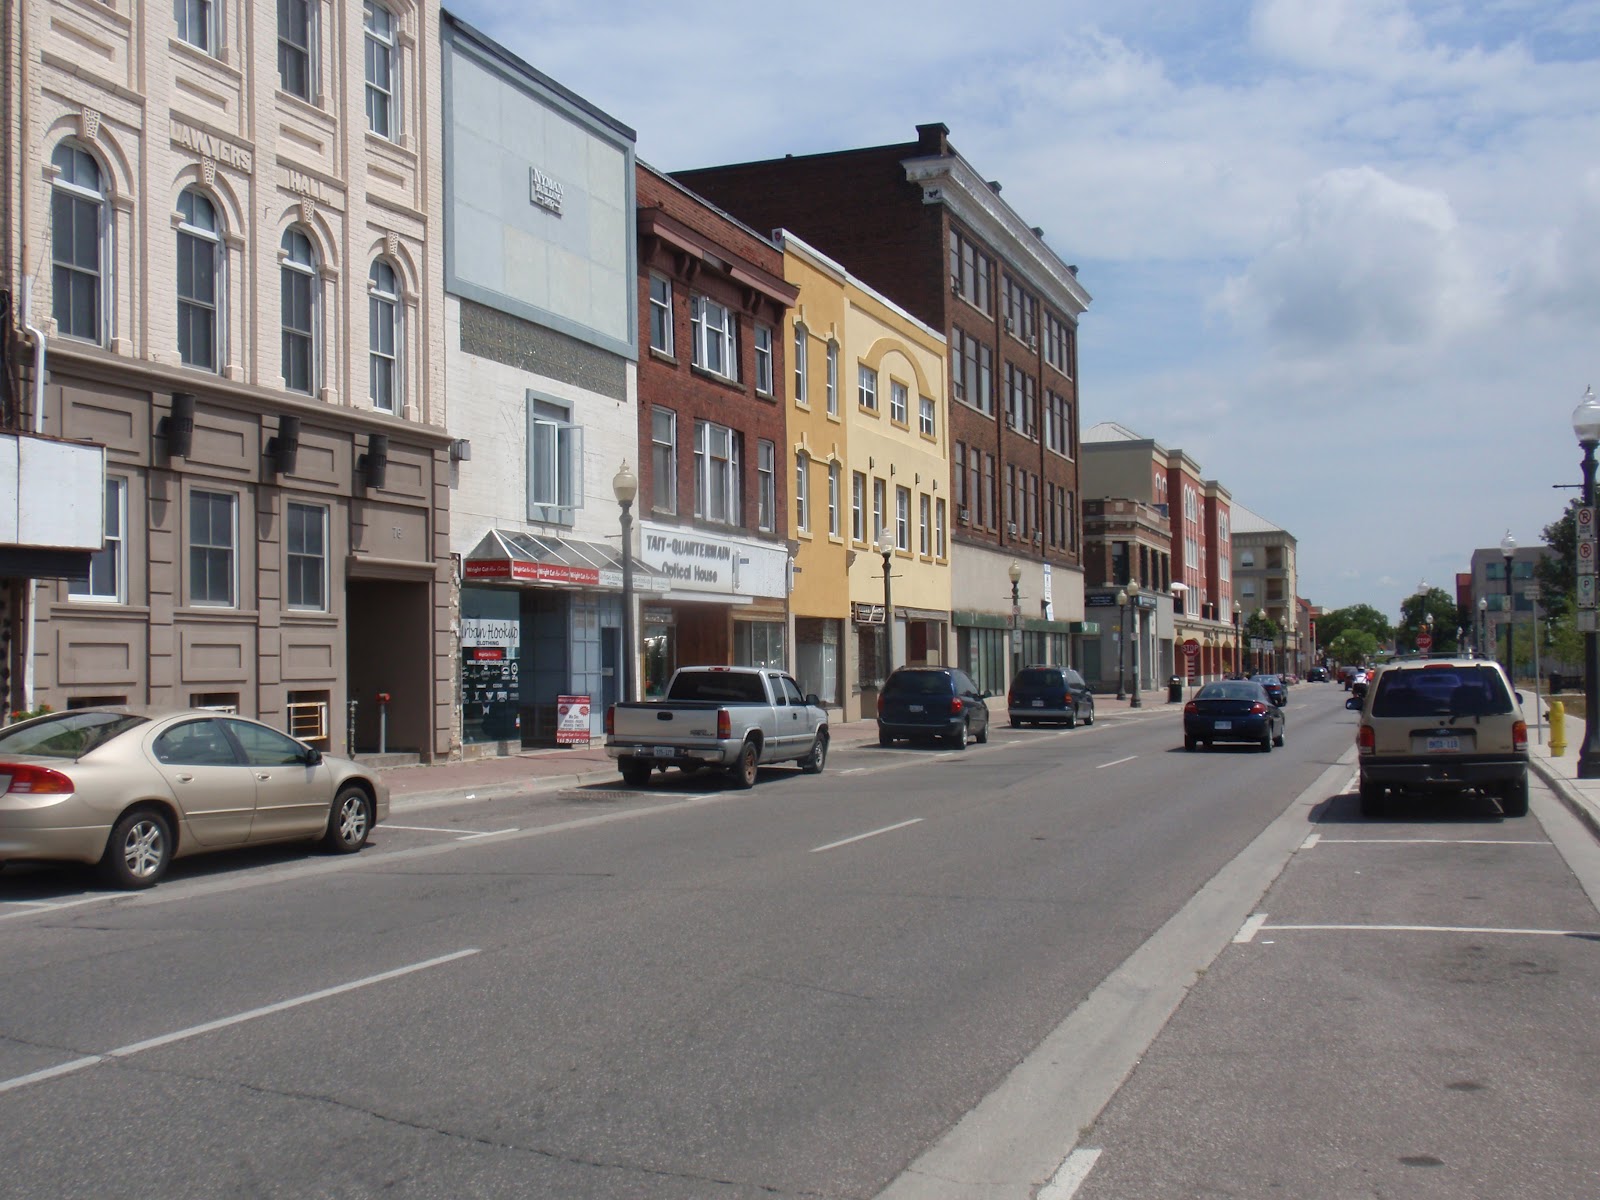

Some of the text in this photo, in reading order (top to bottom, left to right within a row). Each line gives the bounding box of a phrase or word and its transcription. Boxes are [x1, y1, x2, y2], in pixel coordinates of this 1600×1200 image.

[170, 120, 251, 173] LAWYERS
[532, 168, 564, 196] NYMAN
[647, 535, 730, 561] TAIT-QUARTERMAIN
[662, 562, 718, 583] Optical House
[488, 623, 518, 645] Hookup
